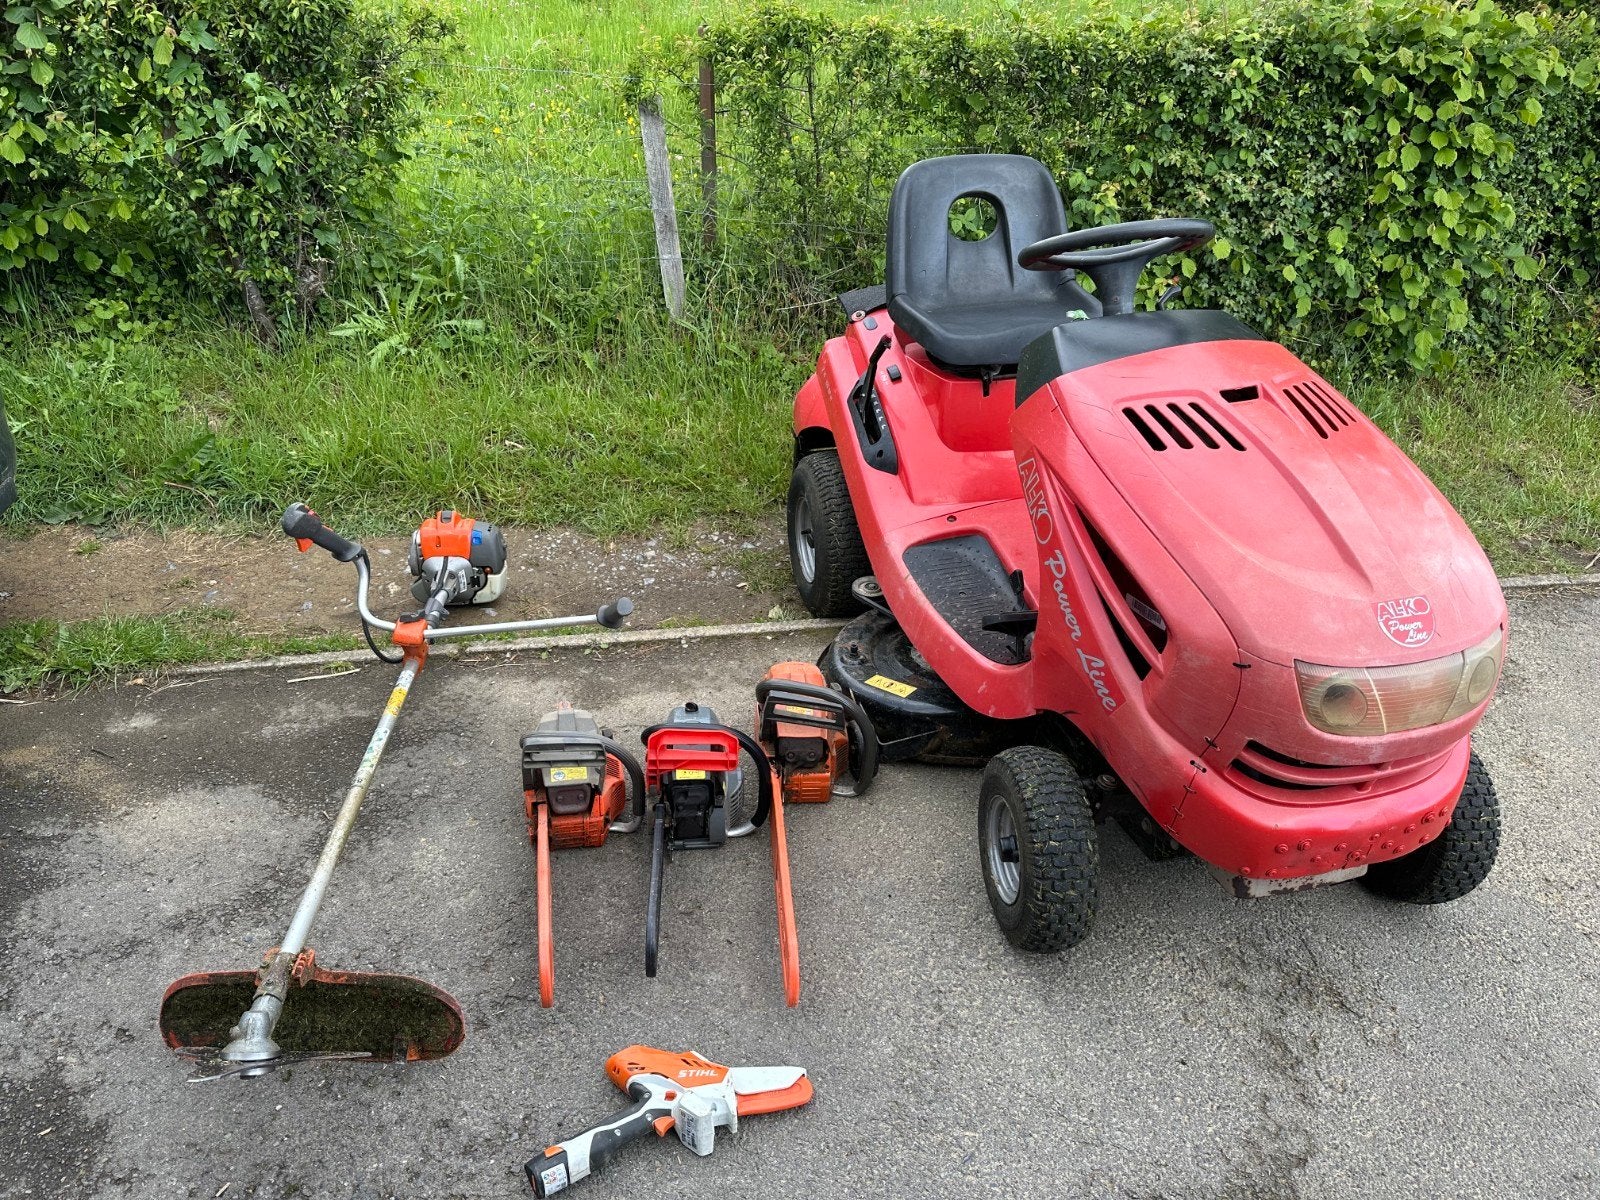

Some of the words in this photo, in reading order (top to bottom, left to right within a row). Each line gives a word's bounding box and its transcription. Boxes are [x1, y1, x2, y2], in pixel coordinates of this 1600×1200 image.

[1044, 549, 1083, 643] Power
[1076, 648, 1118, 712] Line
[1388, 620, 1423, 634] Power
[1405, 629, 1428, 643] Line
[678, 1069, 719, 1078] STIHL
